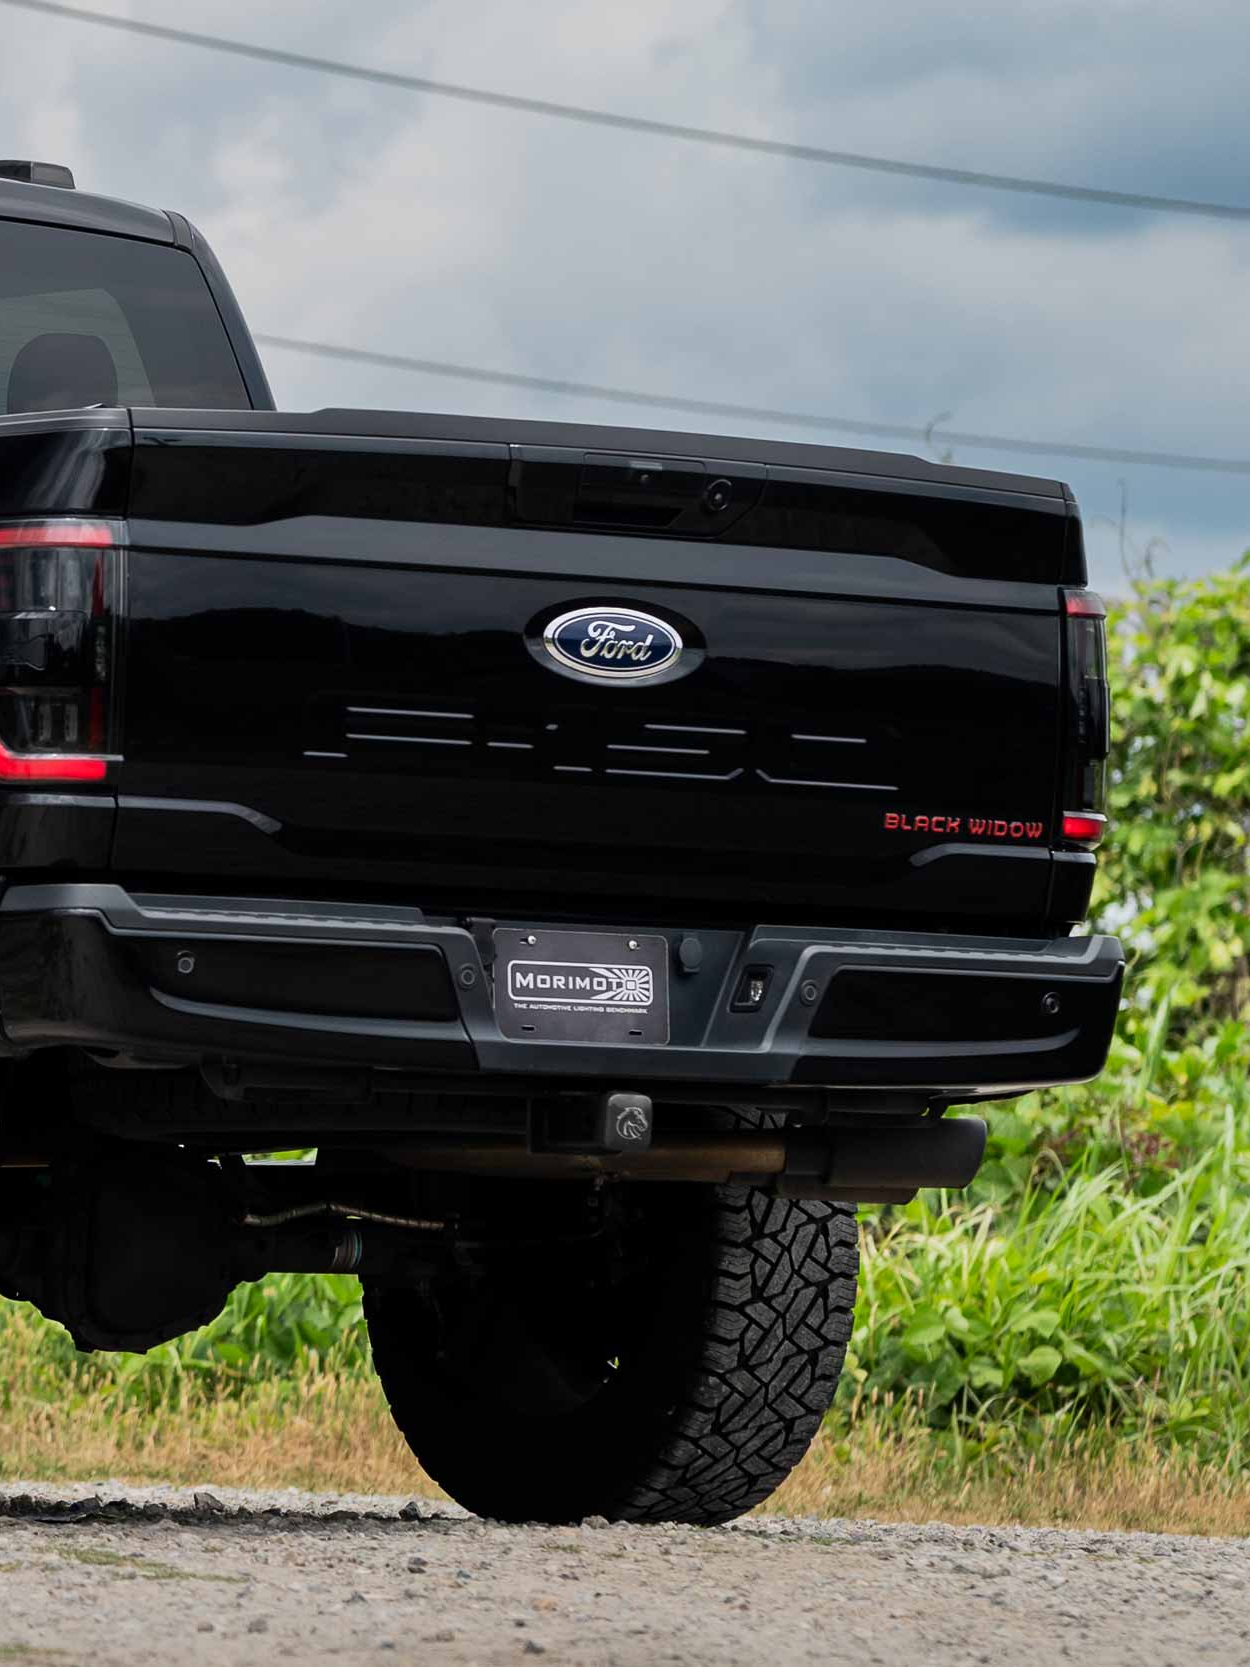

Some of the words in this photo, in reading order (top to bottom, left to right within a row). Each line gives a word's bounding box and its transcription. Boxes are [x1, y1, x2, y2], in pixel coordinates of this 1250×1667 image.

[580, 620, 654, 661] Ford
[883, 812, 961, 833] BLACK
[969, 817, 1043, 839] WIDOW
[529, 1004, 572, 1012] AUTOMOTIVE
[573, 1005, 605, 1013] LIGHTING
